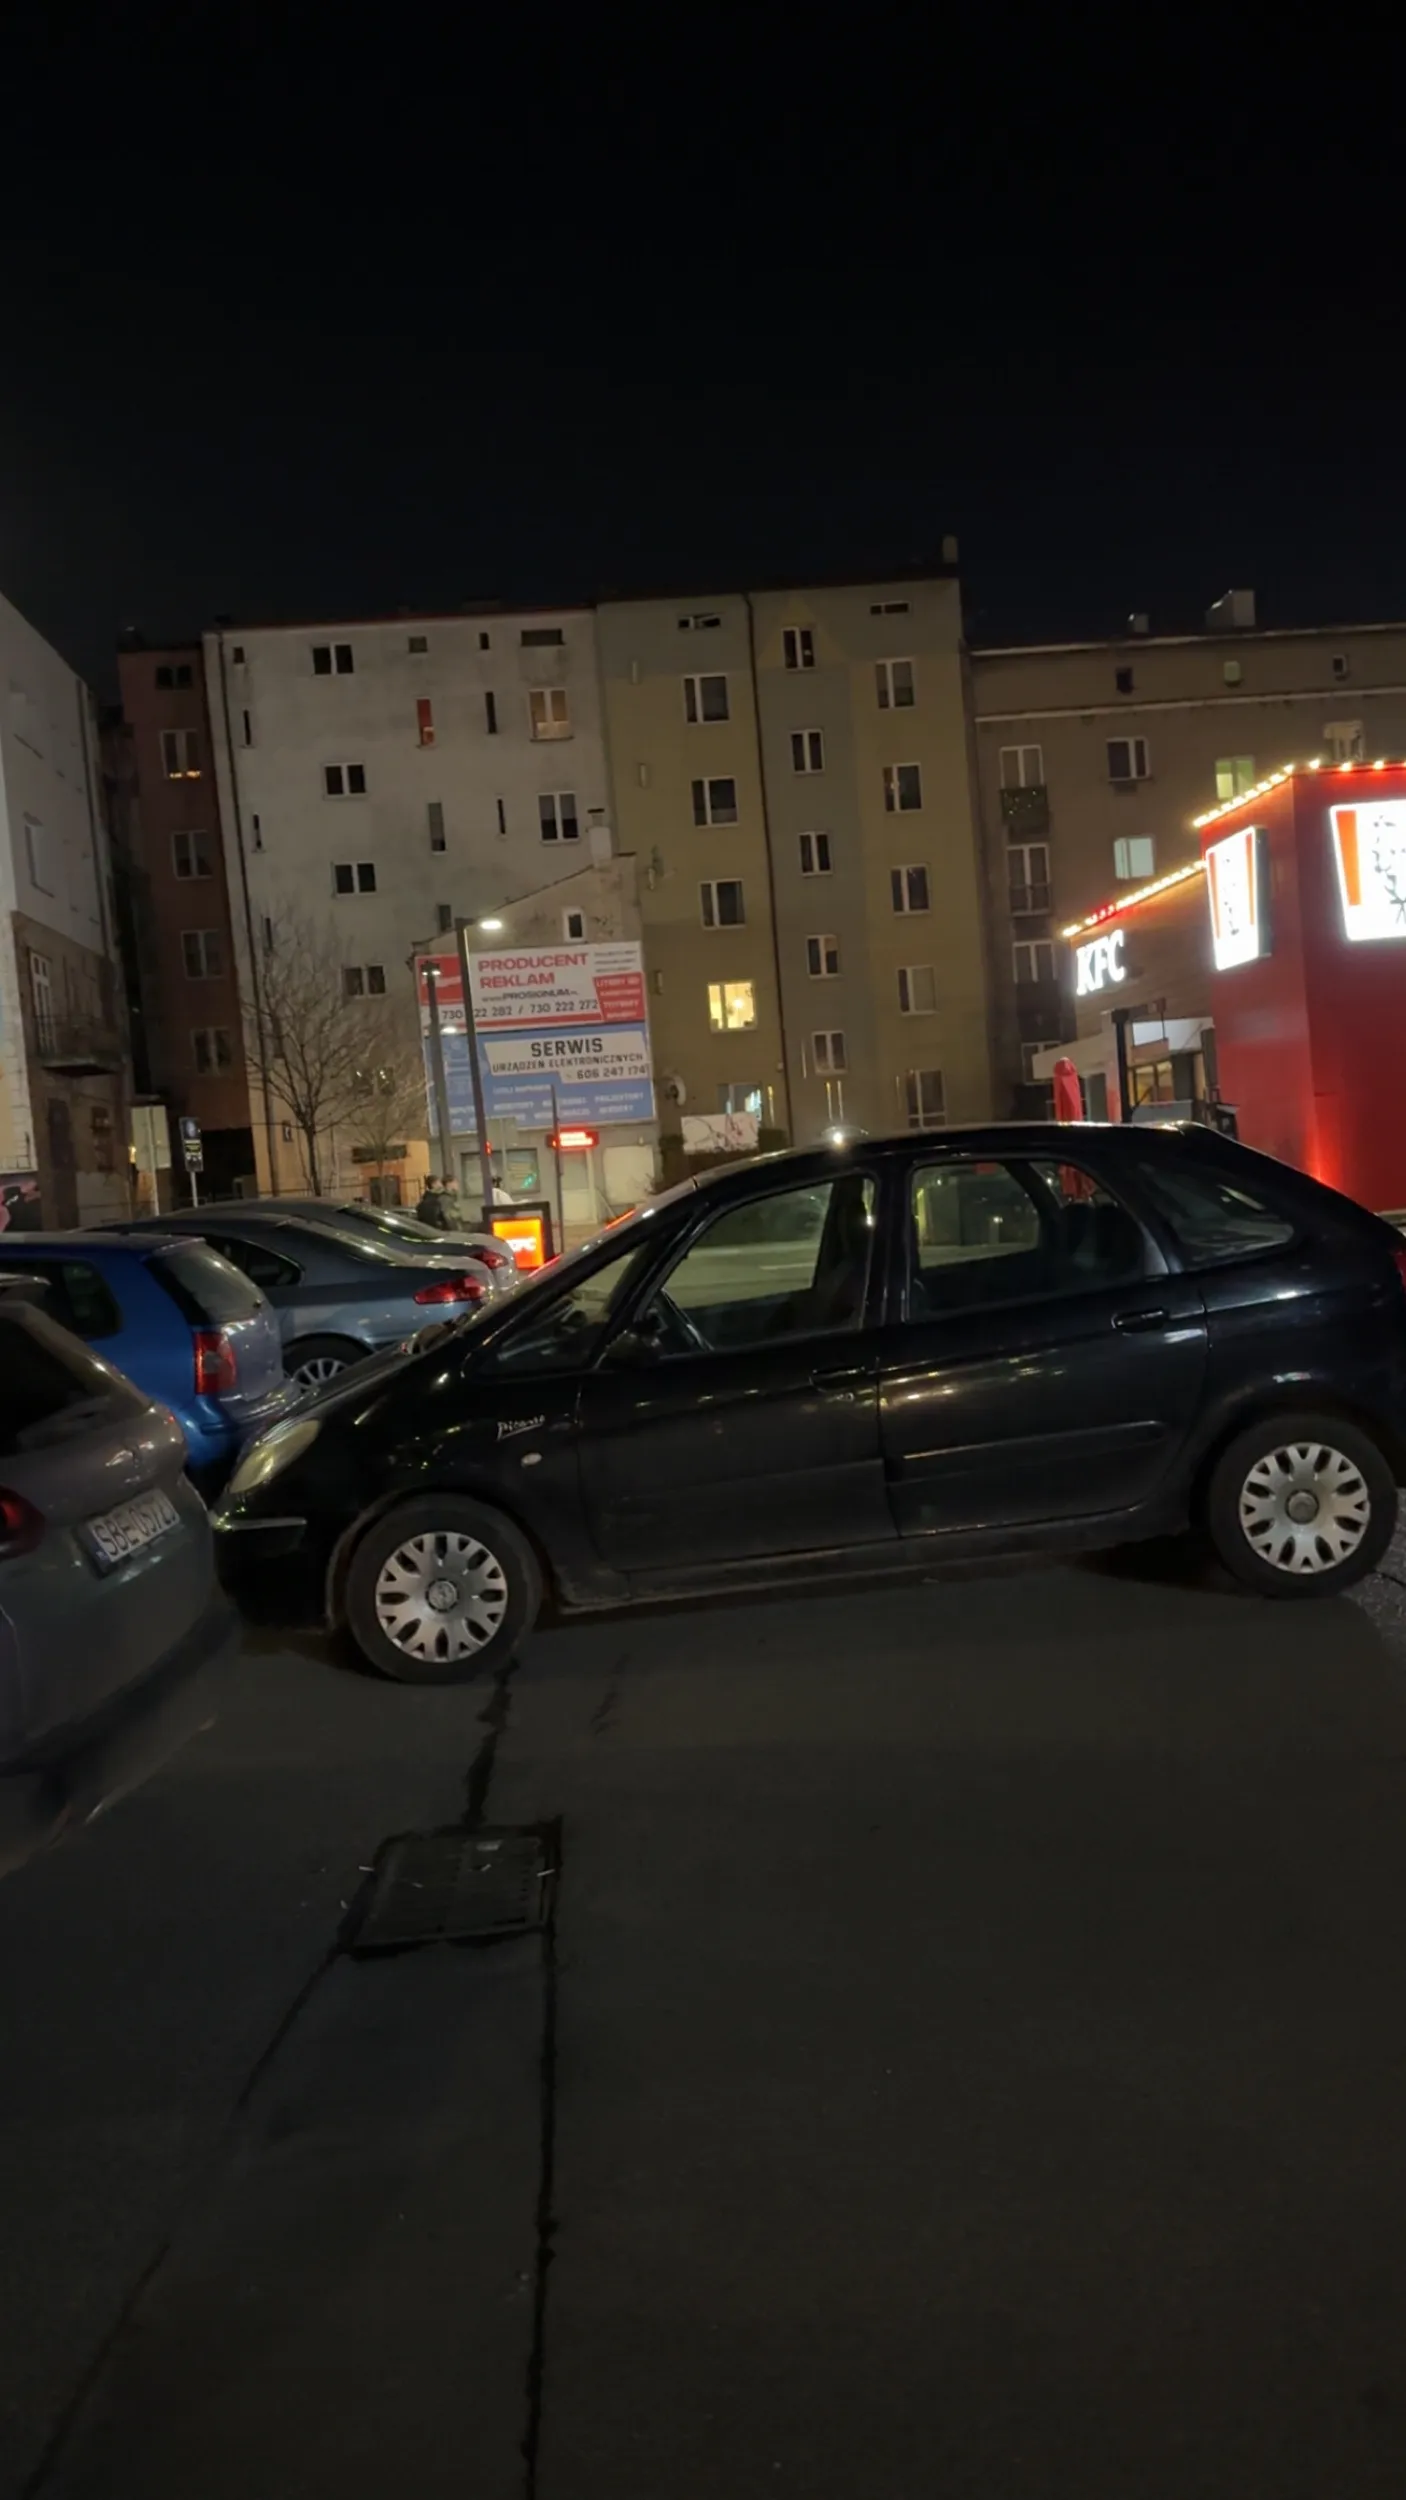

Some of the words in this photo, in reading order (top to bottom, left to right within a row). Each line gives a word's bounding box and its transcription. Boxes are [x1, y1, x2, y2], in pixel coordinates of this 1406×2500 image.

[478, 952, 589, 972] PRODUCENT
[1076, 929, 1125, 996] KFC
[480, 973, 556, 989] REKLAM
[442, 1010, 464, 1020] 730
[473, 1008, 488, 1018] 22
[529, 1003, 551, 1014] 730
[555, 1001, 575, 1012] 222
[579, 999, 599, 1010] 272
[531, 1038, 603, 1058] SERWIS
[549, 1053, 644, 1068] ELEKTRONICZNYCH
